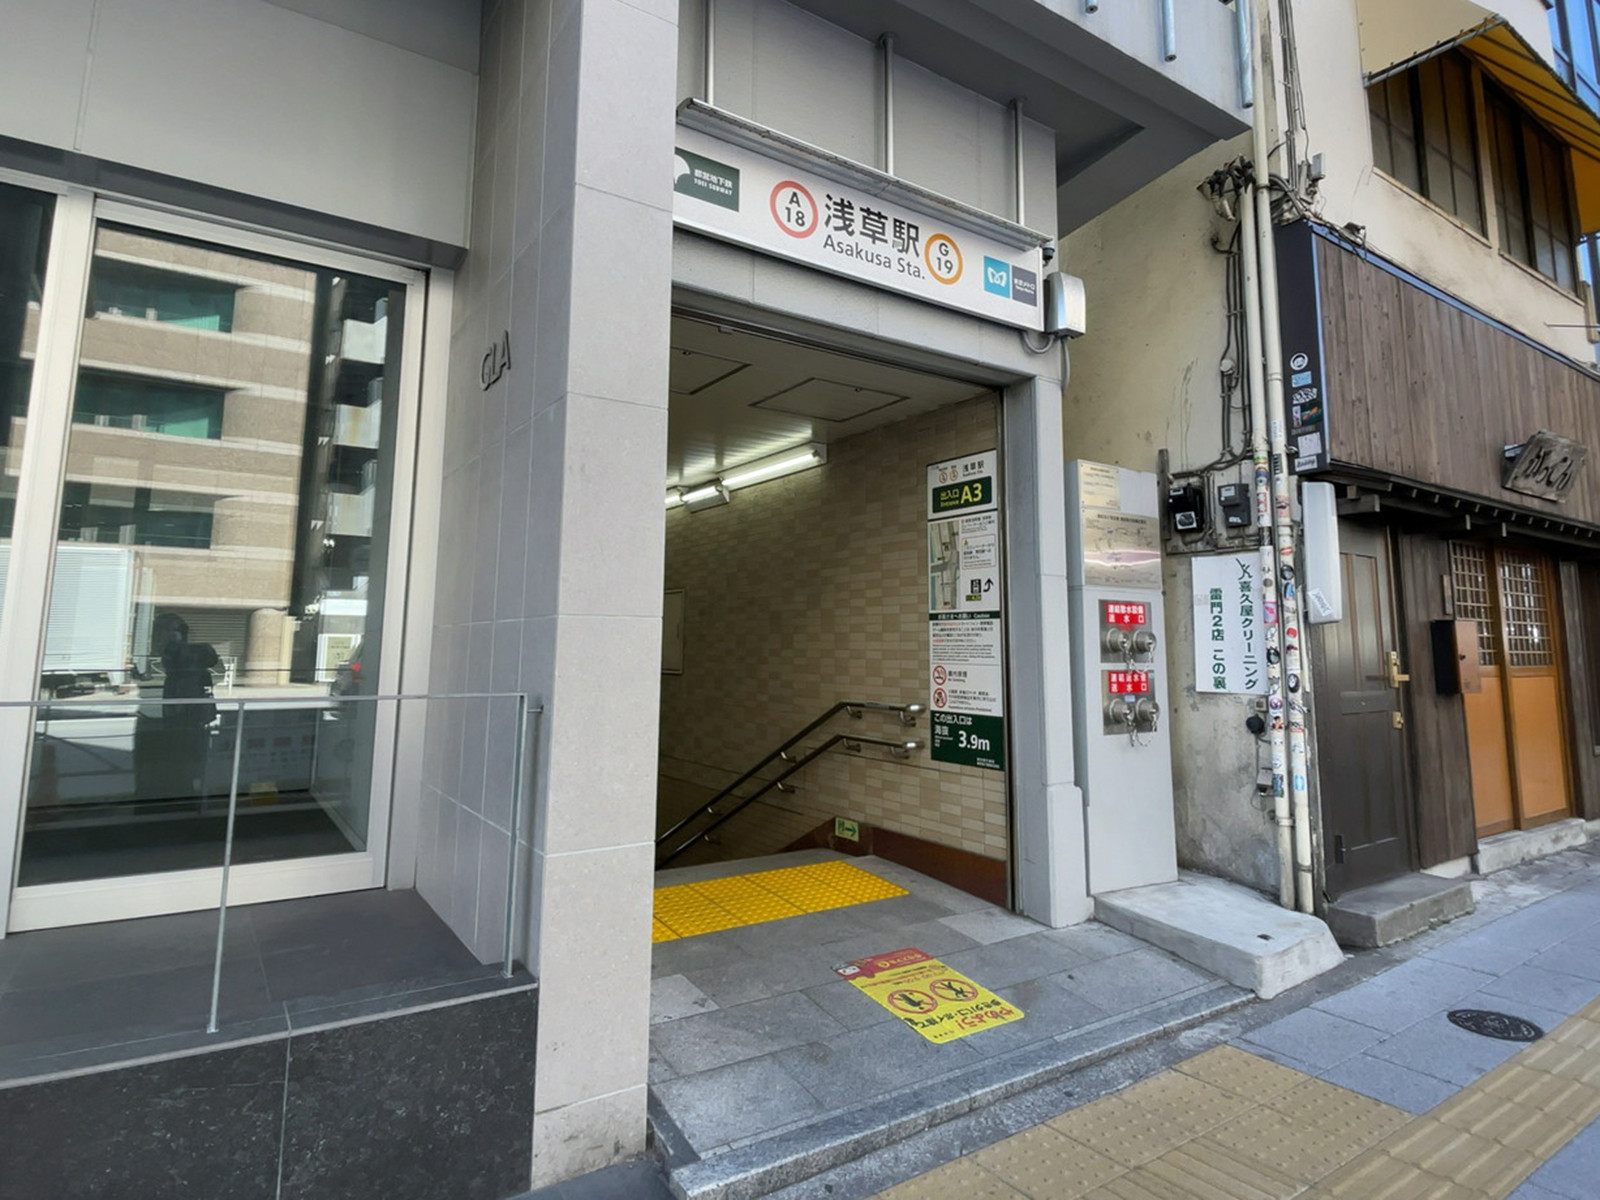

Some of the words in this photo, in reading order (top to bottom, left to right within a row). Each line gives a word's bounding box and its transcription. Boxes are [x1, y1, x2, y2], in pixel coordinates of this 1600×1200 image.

[788, 191, 801, 208] A
[785, 206, 805, 227] 18
[824, 193, 920, 258] 浅草駅
[823, 234, 892, 269] Asakusa
[896, 257, 925, 280] Sta.
[938, 242, 950, 257] G
[936, 256, 954, 274] 19
[960, 483, 983, 504] A3
[958, 730, 990, 751] 3.9m
